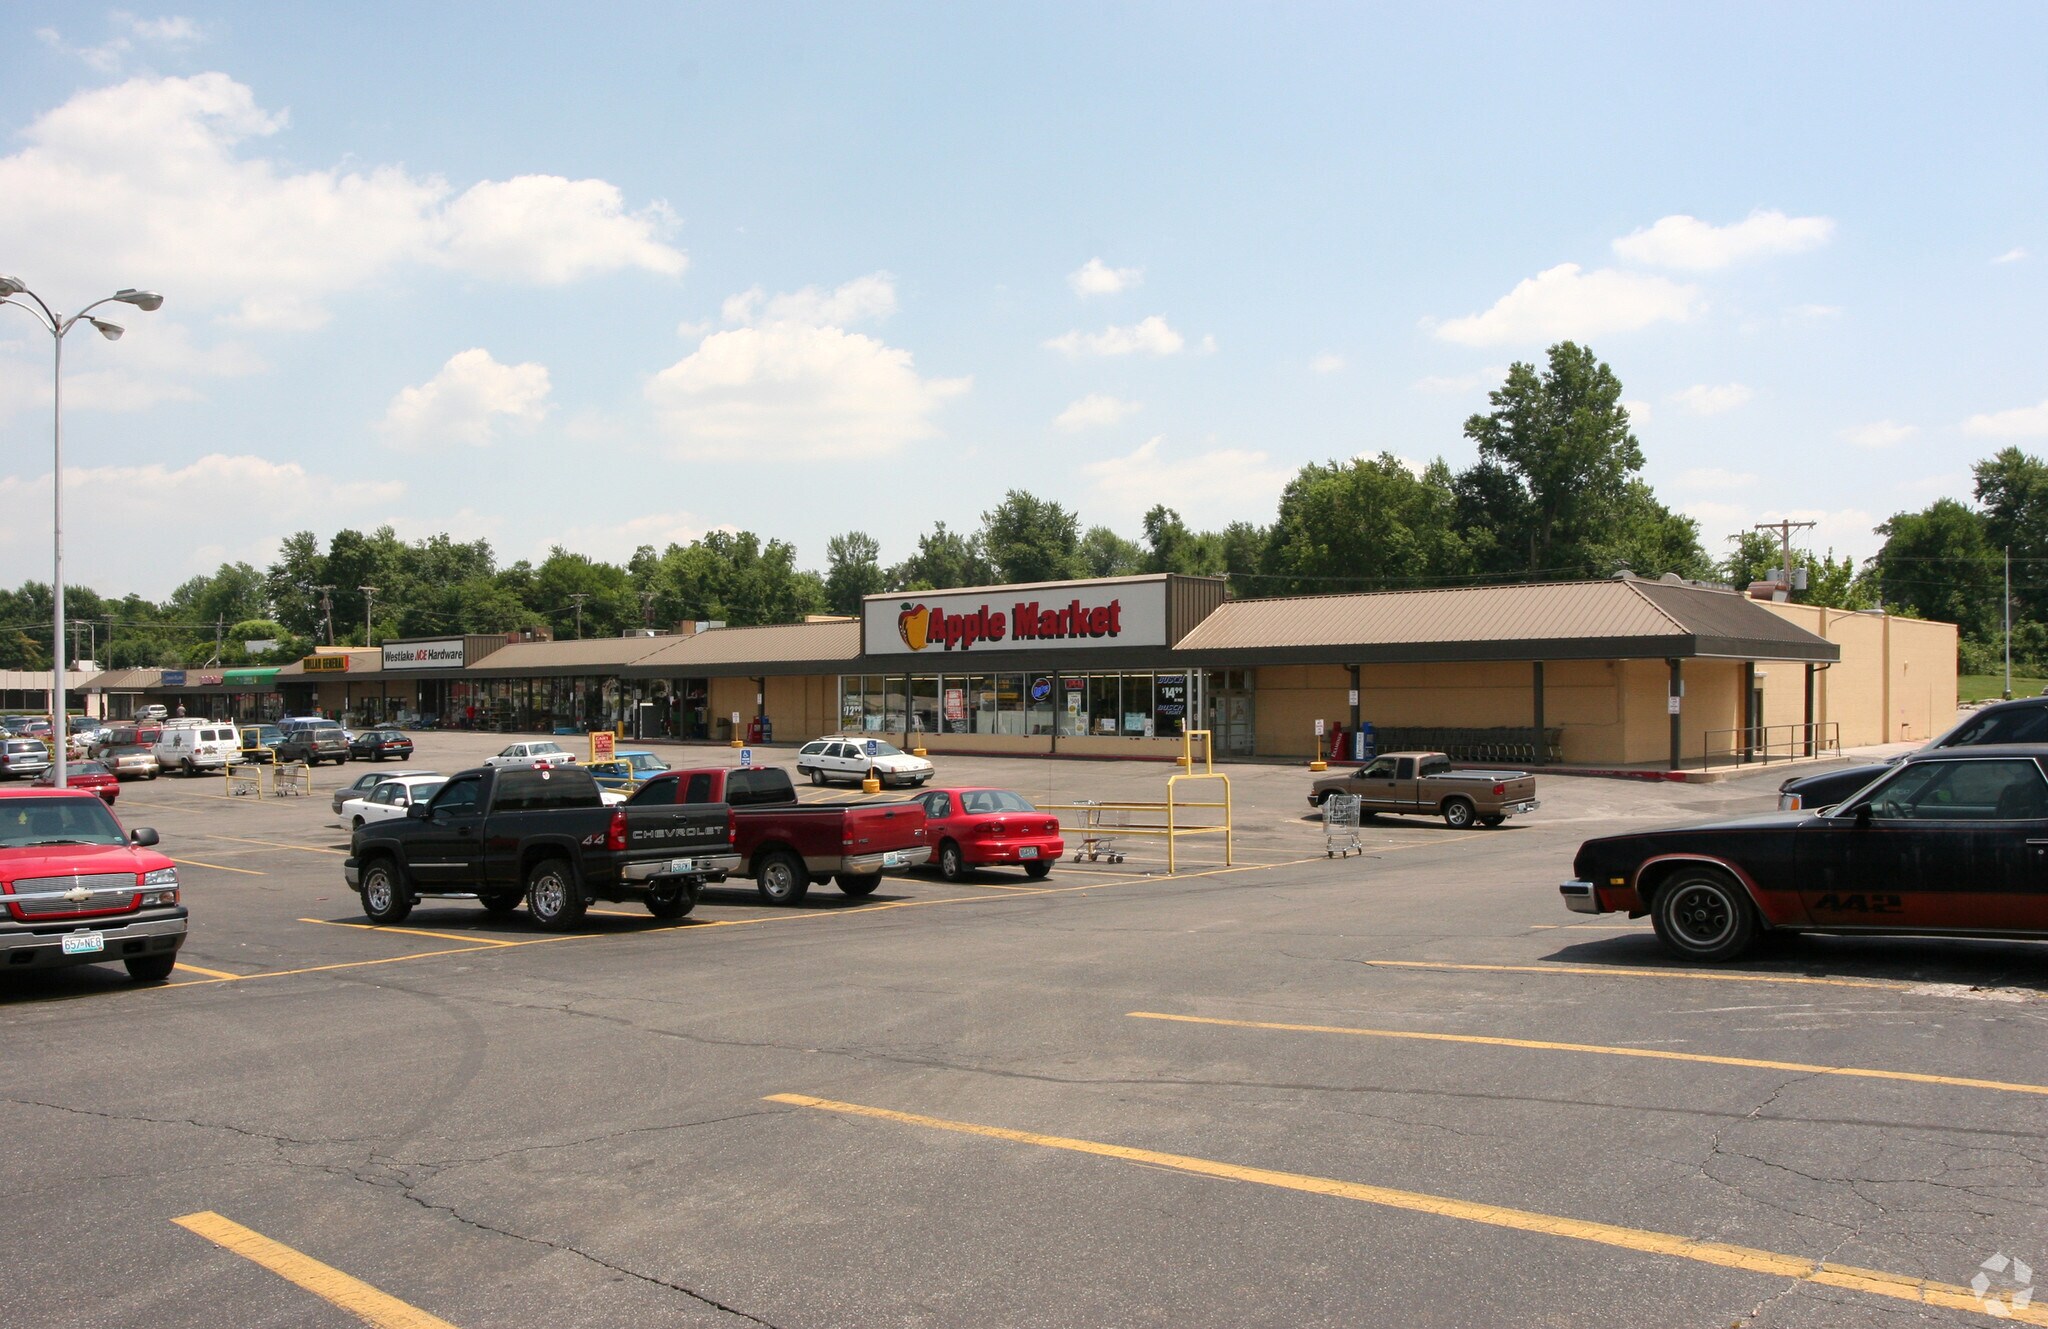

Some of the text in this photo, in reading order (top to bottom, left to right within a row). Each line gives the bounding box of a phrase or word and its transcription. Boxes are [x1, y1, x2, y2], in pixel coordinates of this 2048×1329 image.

[926, 598, 1122, 651] Apple Market
[384, 648, 463, 662] Westlake ACE Hardware
[322, 656, 345, 670] GENERAL
[1157, 675, 1186, 684] BUSCH
[632, 825, 724, 840] CHEVROLET
